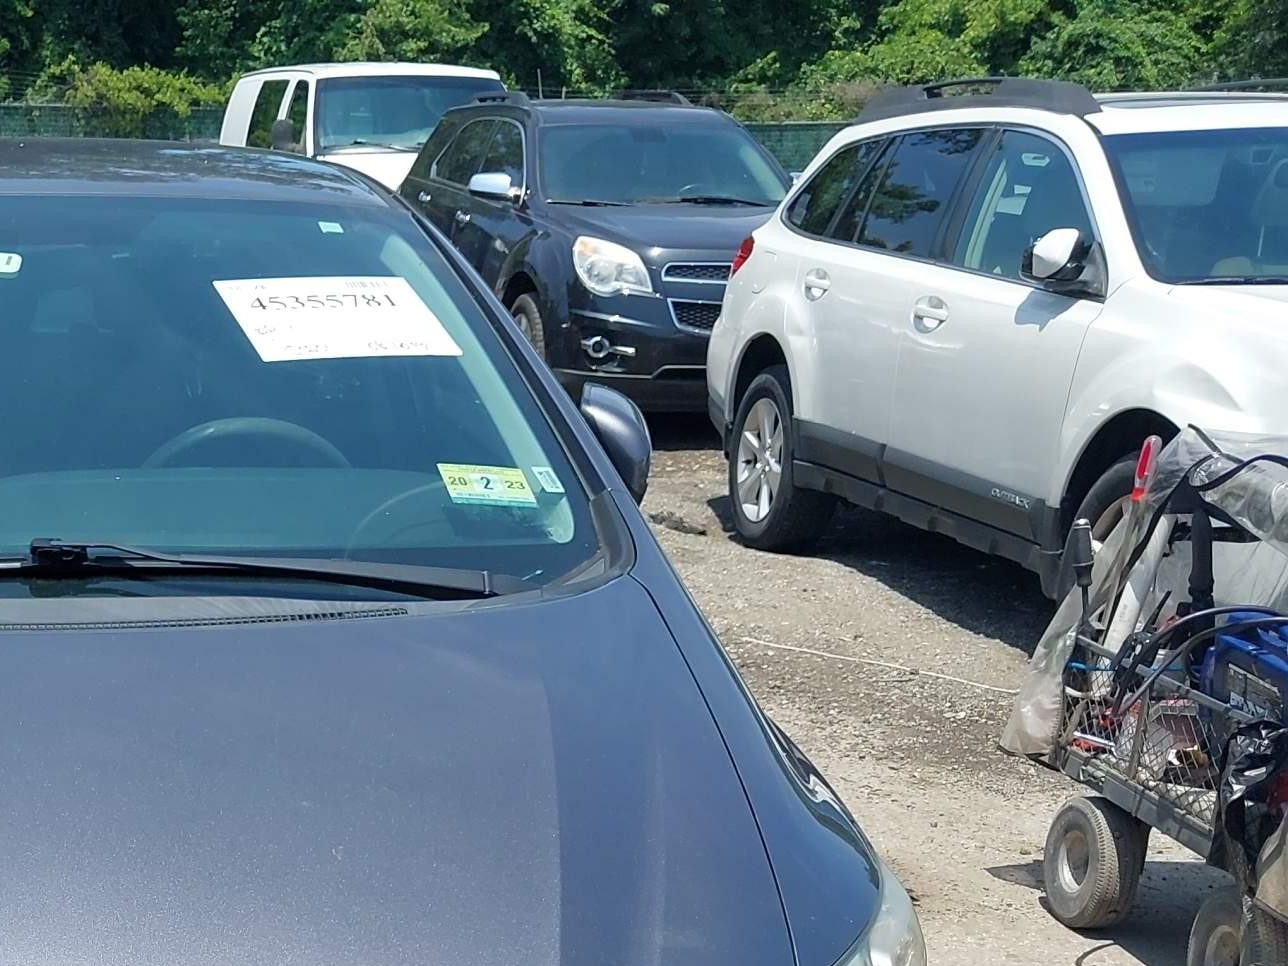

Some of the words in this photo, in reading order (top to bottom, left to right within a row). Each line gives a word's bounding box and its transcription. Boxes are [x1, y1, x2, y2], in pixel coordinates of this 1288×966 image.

[250, 293, 397, 311] 45355781
[448, 476, 468, 486] 20
[480, 476, 494, 490] 2
[504, 480, 526, 490] 23
